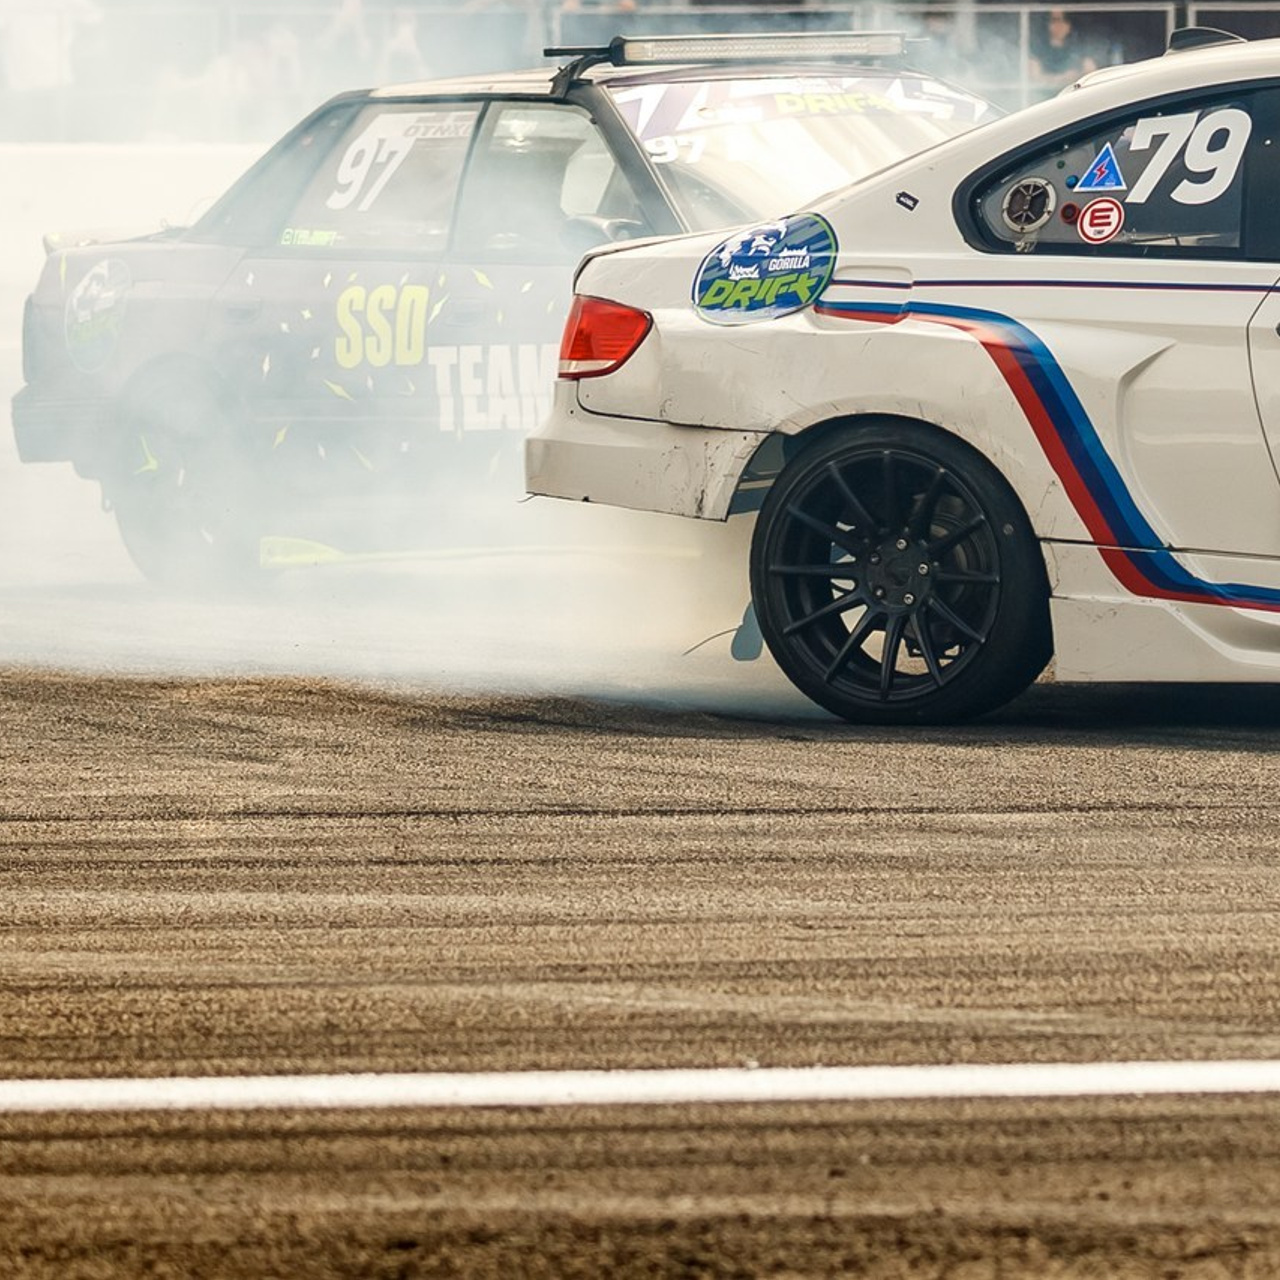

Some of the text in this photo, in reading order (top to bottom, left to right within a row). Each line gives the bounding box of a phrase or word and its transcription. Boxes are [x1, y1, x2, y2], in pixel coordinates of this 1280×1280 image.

[325, 137, 417, 212] 97
[644, 136, 706, 164] 97
[1125, 108, 1252, 205] 79
[699, 273, 818, 308] DRIFT
[768, 256, 810, 271] GORILLA
[335, 285, 430, 369] SSD
